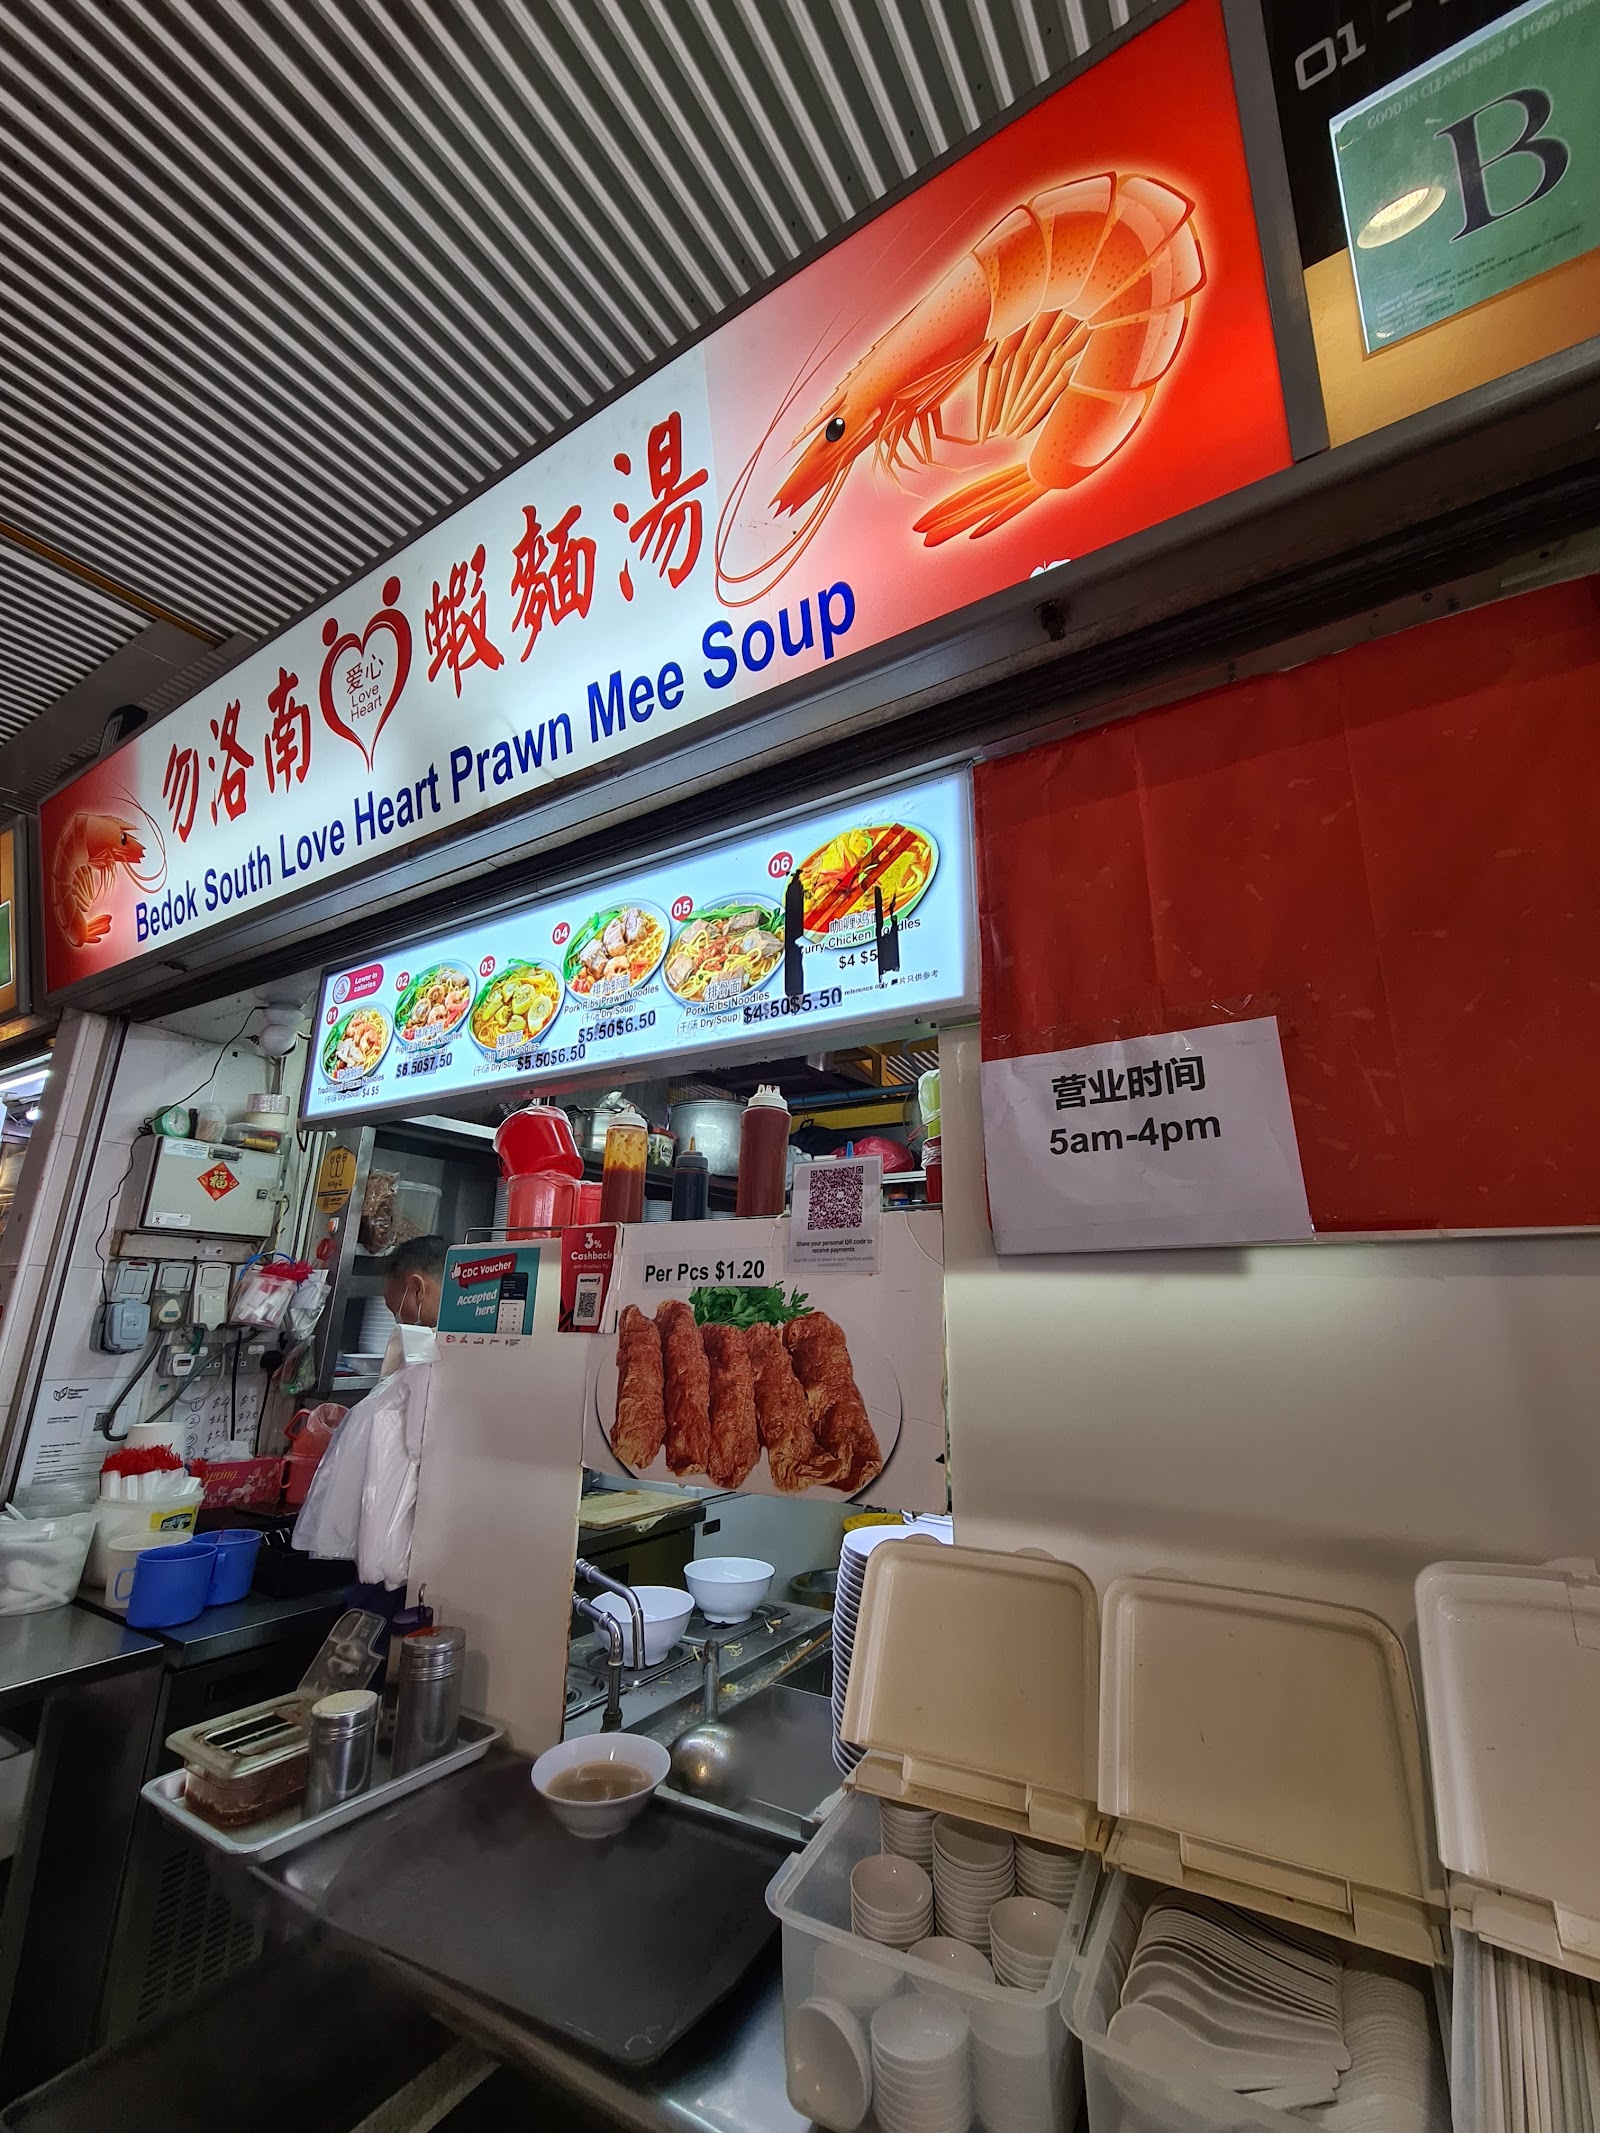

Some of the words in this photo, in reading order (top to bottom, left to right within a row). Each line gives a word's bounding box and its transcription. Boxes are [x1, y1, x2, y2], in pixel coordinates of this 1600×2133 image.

[1295, 20, 1367, 91] 01
[1434, 85, 1571, 244] B
[346, 653, 384, 695] 爱心
[351, 684, 379, 708] Love
[350, 694, 382, 722] Heart
[136, 889, 199, 943] Bedok
[205, 845, 272, 912] South
[279, 821, 346, 879] Love
[353, 763, 441, 847] Heart
[450, 711, 573, 804] Prawn
[587, 659, 685, 743] Mee
[701, 581, 856, 690] Soup
[163, 666, 312, 843] 勿洛南
[771, 858, 790, 873] 06
[673, 902, 691, 915] 05
[553, 928, 569, 940] 04
[828, 930, 871, 948] Chicken
[482, 960, 494, 973] 03
[839, 953, 855, 969] $4
[860, 949, 878, 965] $5
[353, 981, 377, 993] calories
[354, 974, 372, 985] Lower
[397, 975, 409, 988] 02
[891, 969, 939, 987] 片只供参考
[707, 979, 741, 999] 排骨面
[844, 986, 873, 995] reference
[564, 1004, 581, 1015] Pork
[583, 999, 600, 1009] Ribs
[601, 993, 626, 1005] Prawn
[627, 984, 660, 999] Noodles
[685, 1006, 706, 1017] Pork
[708, 1000, 728, 1012] Ribs
[731, 990, 770, 1007] Noodles
[327, 1009, 337, 1022] 01
[395, 1045, 405, 1055] Pig
[437, 1031, 463, 1044] Noodles
[484, 1051, 495, 1062] Pig
[497, 1048, 510, 1059] Tail
[510, 1042, 540, 1056] Noodles
[362, 1087, 370, 1098] $4
[371, 1085, 379, 1096] $5
[1051, 1055, 1207, 1111] 营业时间
[1050, 1115, 1222, 1155] 5am-4pm
[209, 1170, 228, 1190] 福
[584, 1232, 602, 1249] 3%
[822, 1239, 844, 1247] personal
[844, 1238, 853, 1246] QR
[570, 1250, 613, 1260] Cashback
[830, 1246, 855, 1254] payments
[461, 1266, 479, 1279] CDC
[480, 1260, 512, 1275] Voucher
[644, 1264, 673, 1283] Per
[677, 1263, 710, 1281] Pcs
[715, 1259, 765, 1282] $1.20
[457, 1289, 498, 1307] Accepted
[475, 1305, 496, 1317] here
